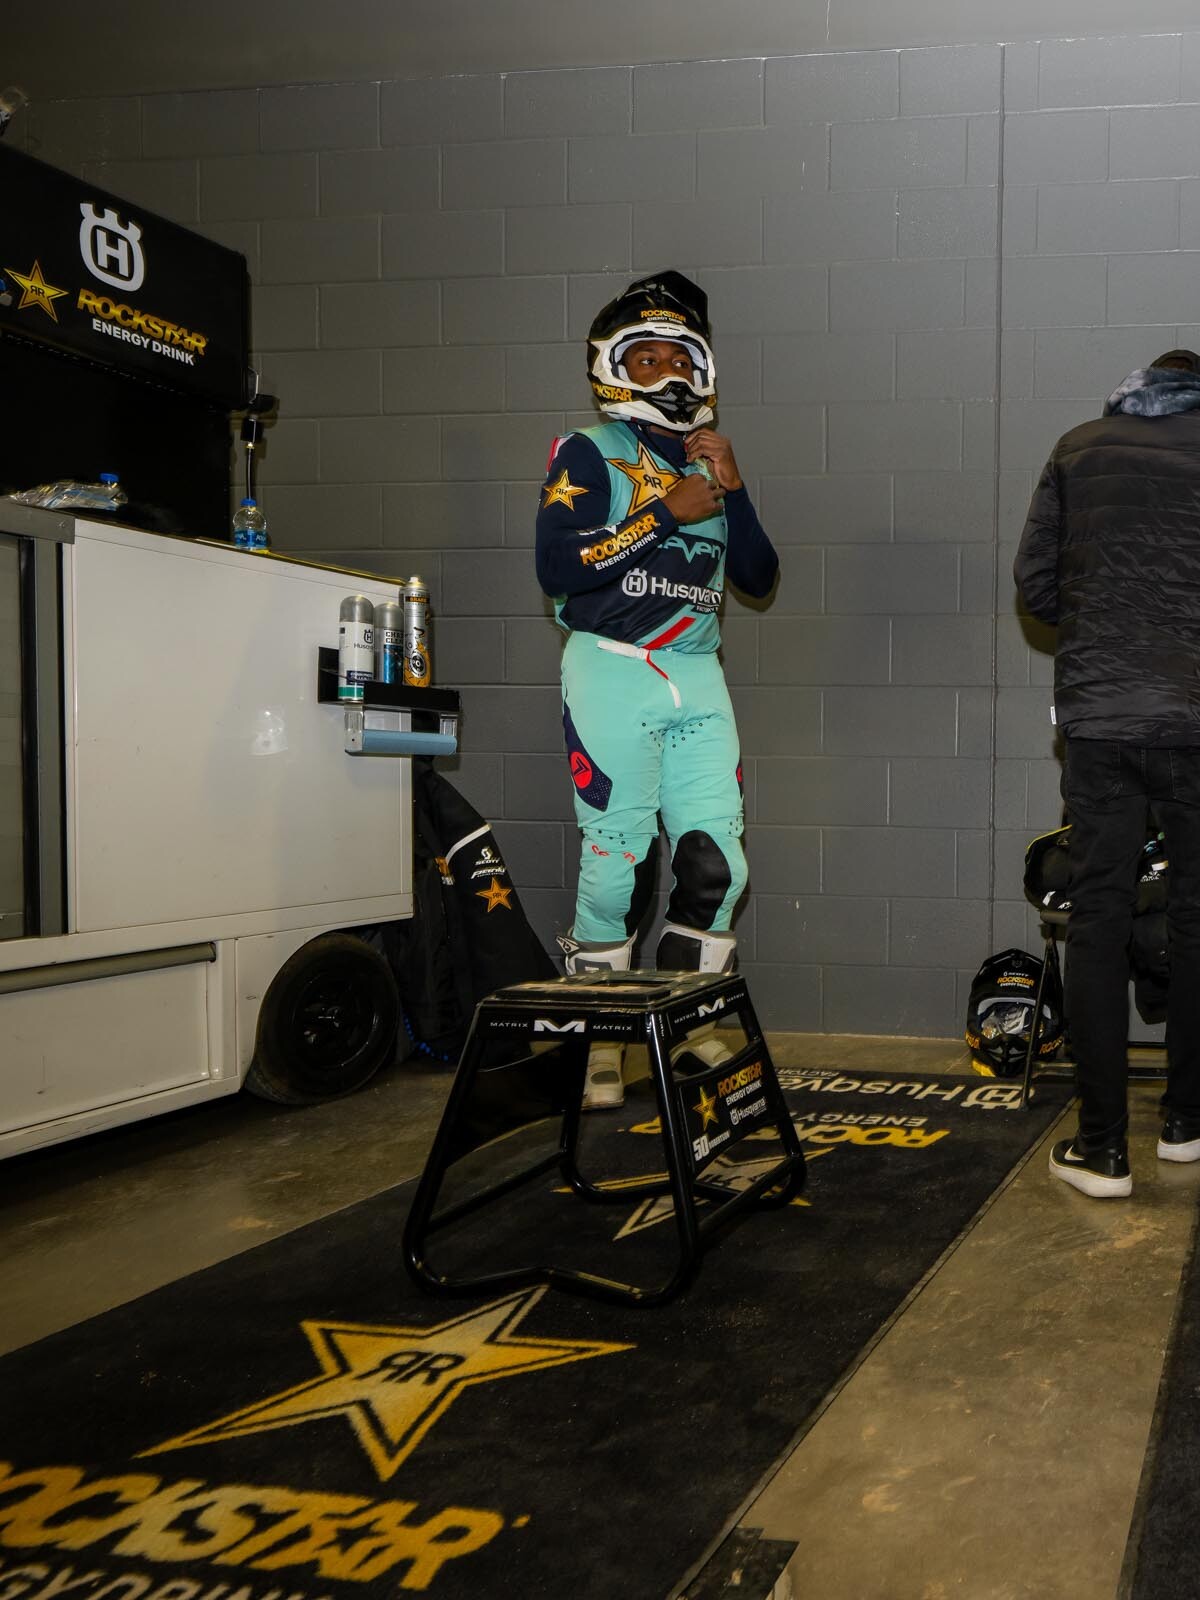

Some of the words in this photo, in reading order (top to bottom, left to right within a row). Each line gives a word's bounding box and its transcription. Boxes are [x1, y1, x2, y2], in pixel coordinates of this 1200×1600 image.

[77, 288, 208, 357] ROCKSTAR
[641, 309, 687, 323] ROCKSTAR
[92, 318, 150, 349] ENERGY
[152, 340, 195, 366] DRINK
[580, 513, 657, 567] ROCKSTAR
[594, 550, 631, 572] ENERGY
[630, 532, 659, 554] DRINK
[997, 975, 1036, 987] ROCKSTAR
[489, 1021, 529, 1029] MATRIX
[534, 1018, 586, 1034] M
[592, 1024, 632, 1032] MATRIX
[717, 1061, 764, 1098] ROCKSTAR
[726, 1086, 747, 1107] ENERGY
[746, 1080, 763, 1096] DRINK
[692, 1134, 711, 1162] 50
[0, 1462, 504, 1591] OCKSTAR
